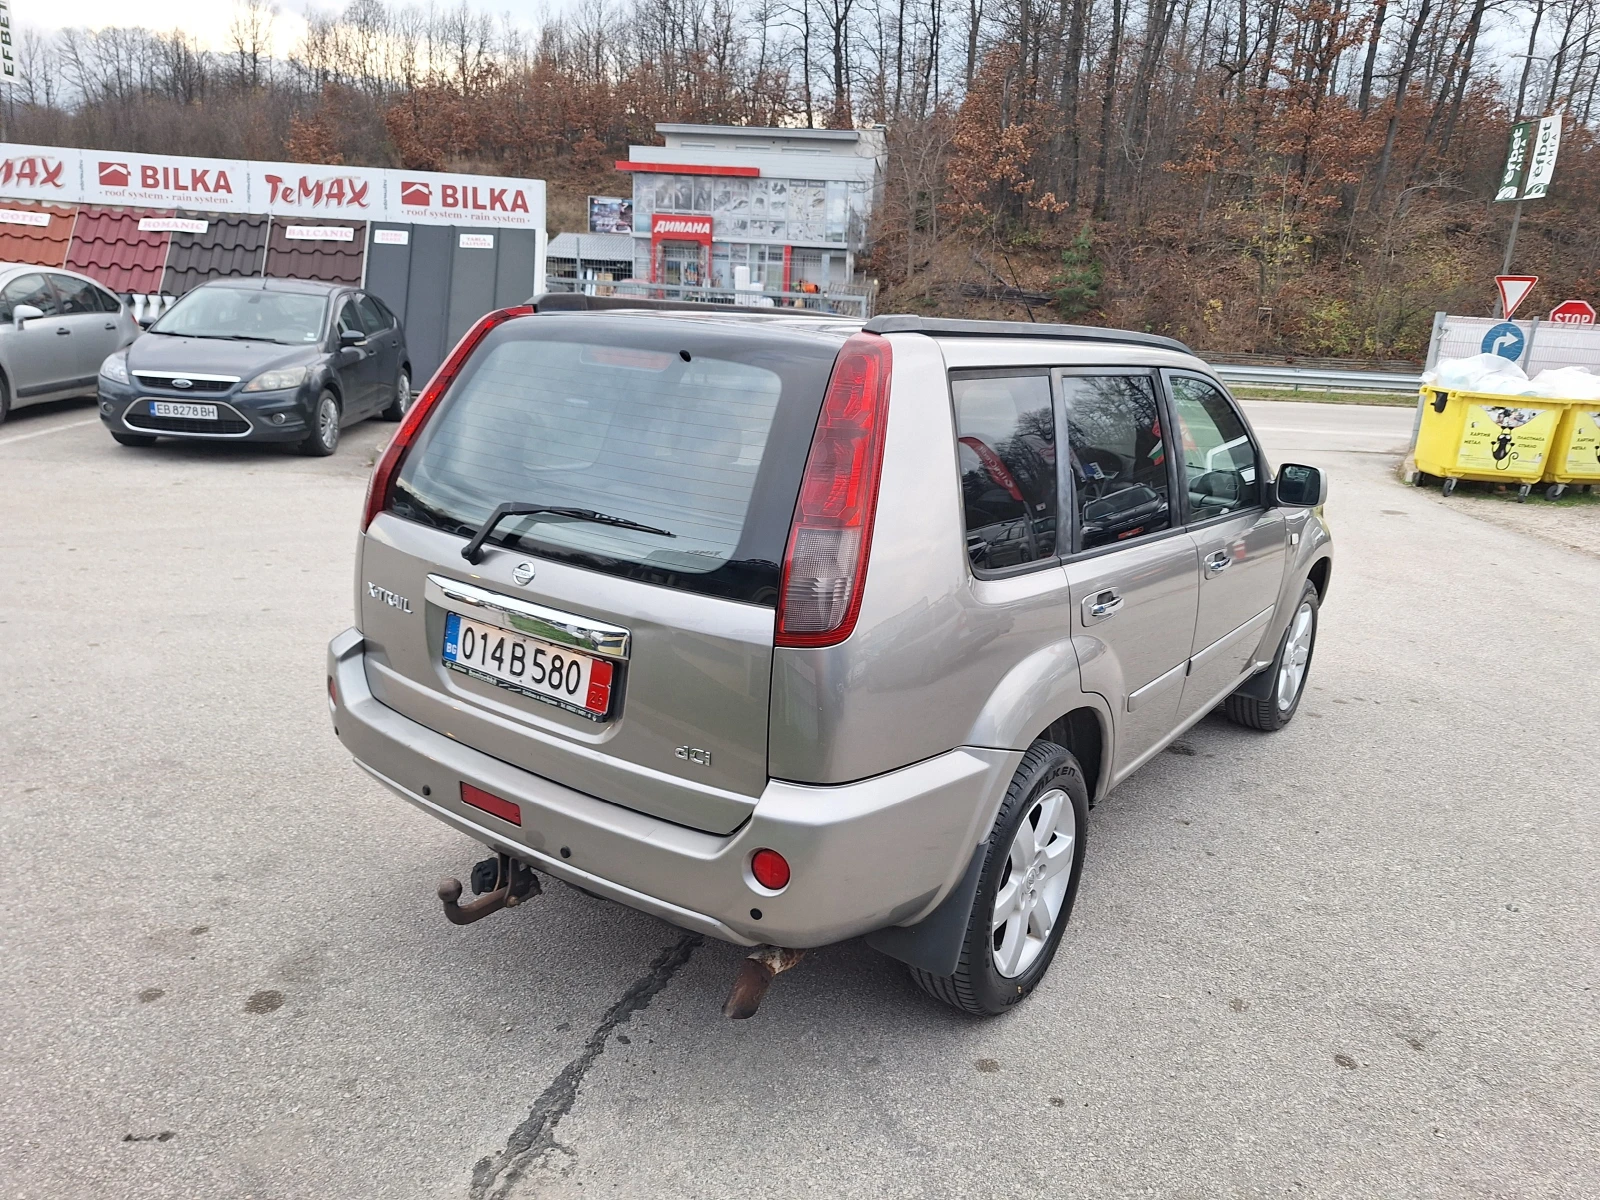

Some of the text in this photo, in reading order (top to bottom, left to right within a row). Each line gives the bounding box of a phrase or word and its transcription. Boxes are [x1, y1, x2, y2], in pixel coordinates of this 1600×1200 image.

[1533, 121, 1552, 178] efbet
[141, 165, 233, 194] BILKA
[105, 189, 228, 204] roof system rain system
[264, 174, 369, 208] TeMAX
[441, 184, 530, 213] BILKA
[1, 212, 43, 223] GOTIC
[407, 208, 525, 223] roof system rain system
[143, 219, 204, 230] ROMANIC
[653, 220, 710, 234] ДИМАНА
[287, 227, 352, 238] BALCANIC
[1554, 313, 1591, 324] STOP
[156, 404, 215, 417] EB 8278 BH
[367, 581, 413, 614] X-TRAIL
[446, 642, 457, 655] BG
